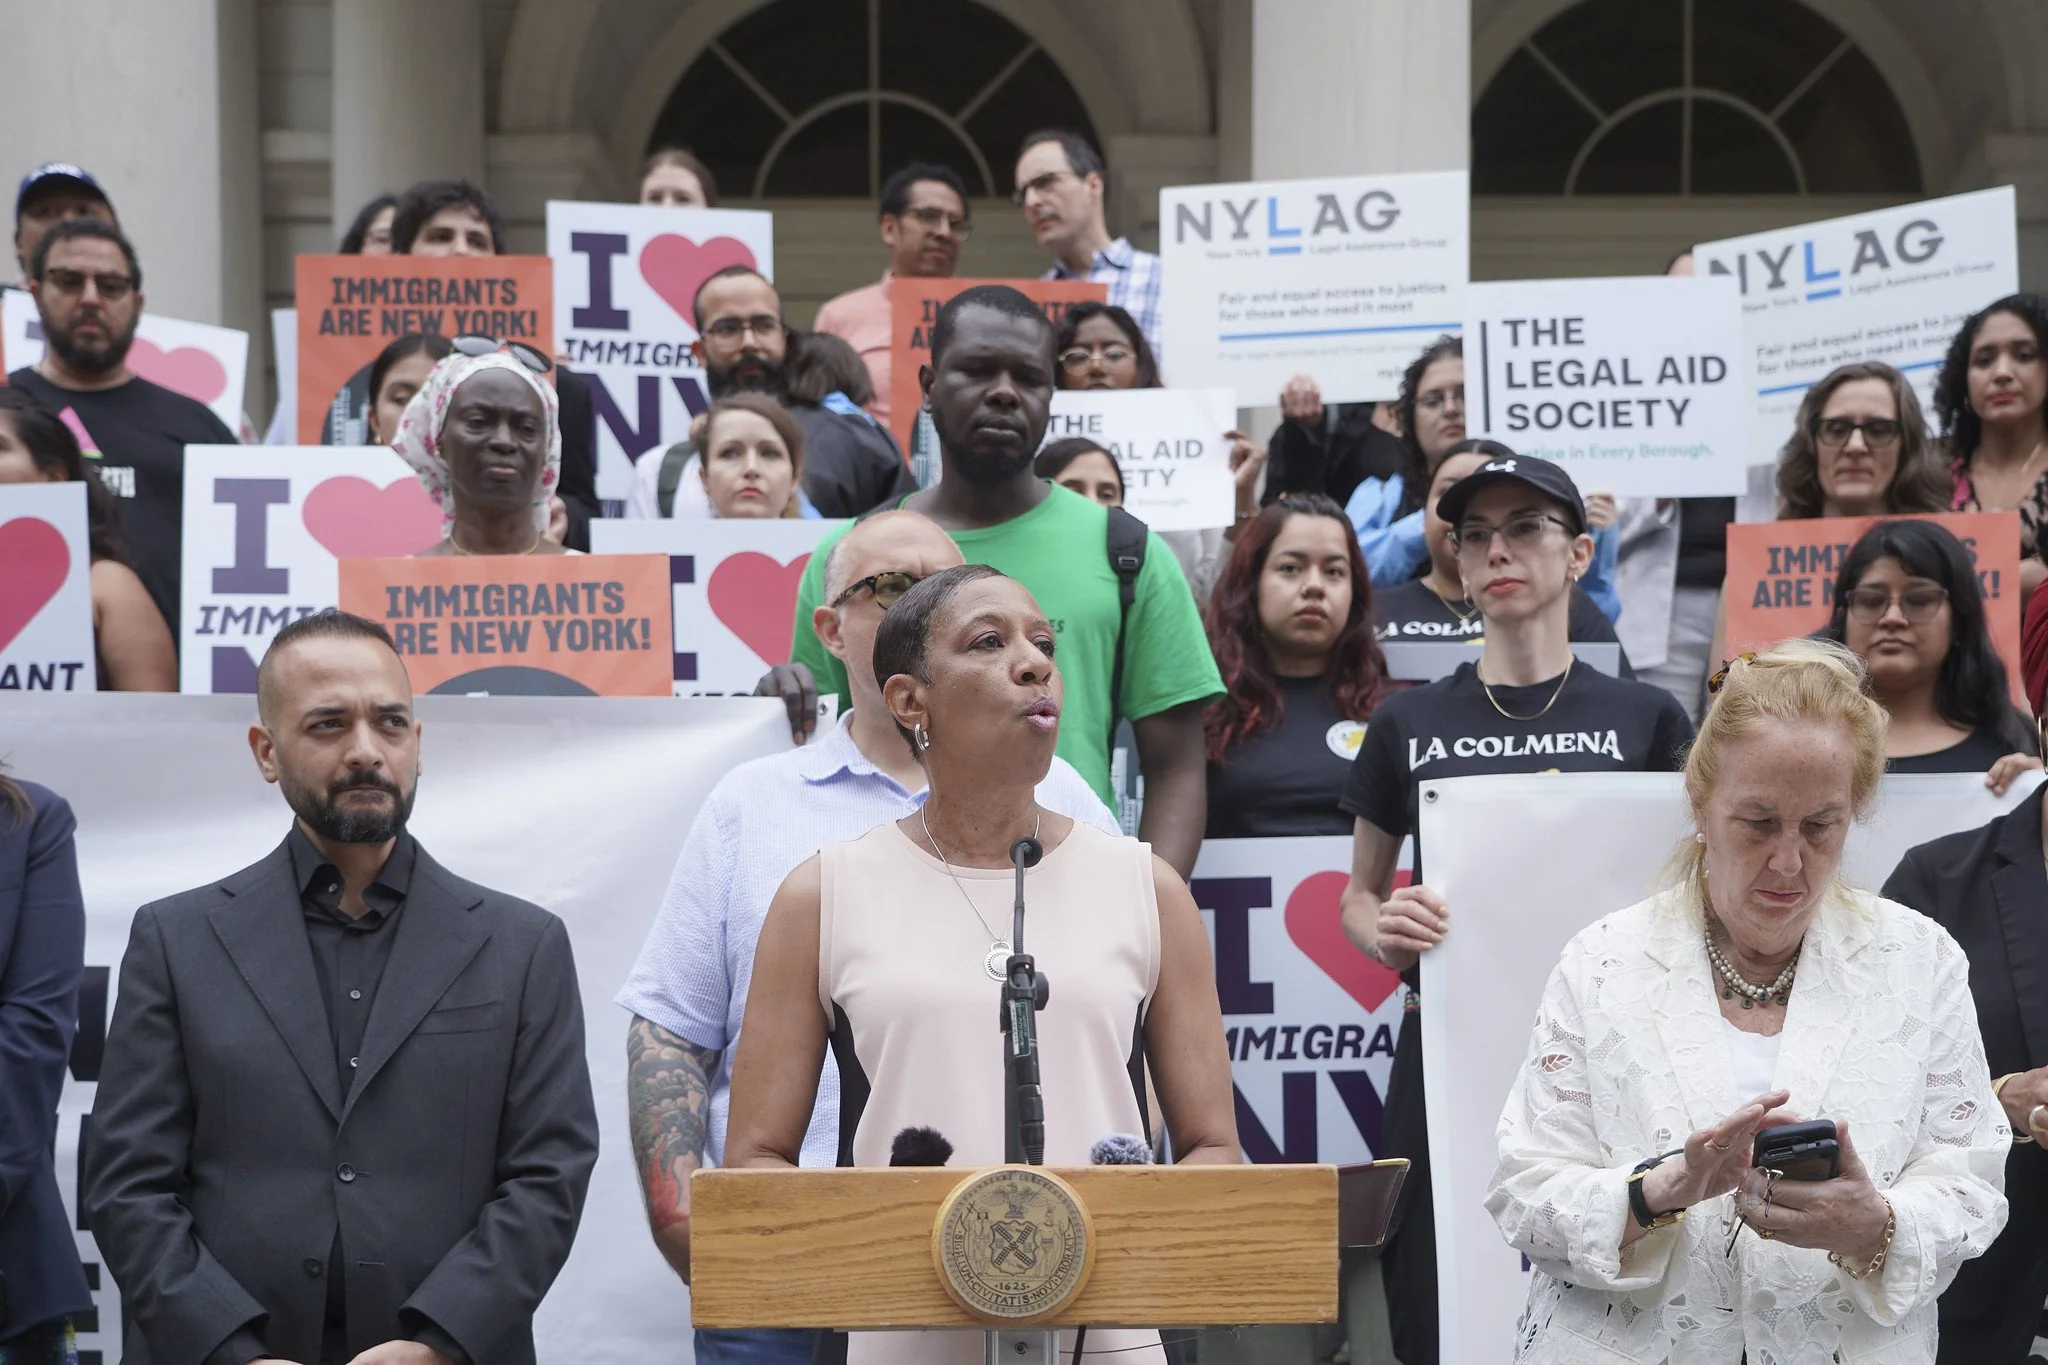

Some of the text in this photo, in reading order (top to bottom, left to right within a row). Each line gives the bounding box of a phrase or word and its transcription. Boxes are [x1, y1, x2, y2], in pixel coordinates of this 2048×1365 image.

[1175, 190, 1401, 244] NYLAG
[332, 278, 517, 305] IMMIGRANTS
[571, 231, 629, 331] I
[1218, 282, 1448, 306] Fair and equal access to justice
[319, 308, 538, 337] ARE NEW YORK!
[1245, 308, 1286, 321] those
[1290, 306, 1320, 319] who
[1323, 304, 1360, 317] need
[1377, 302, 1413, 314] most
[1503, 318, 1585, 347] THE
[1506, 355, 1728, 389] LEGAL AID
[1050, 414, 1104, 434] THE
[1507, 398, 1691, 431] SOCIETY
[1153, 439, 1204, 461] AID
[1569, 446, 1585, 459] in
[1589, 444, 1633, 461] Every
[1640, 442, 1714, 461] Borough.
[211, 477, 290, 595] I
[386, 581, 625, 618] IMMIGRANTS
[1752, 578, 1812, 608] ARE
[451, 620, 532, 654] NEW
[544, 618, 652, 652] YORK!
[1402, 619, 1484, 637] COLM
[1408, 736, 1448, 772] LA
[1453, 729, 1625, 761] COLMENA
[1190, 876, 1274, 1015] I
[972, 1280, 1031, 1305] CIVITATIS
[999, 1282, 1028, 1291] 1625
